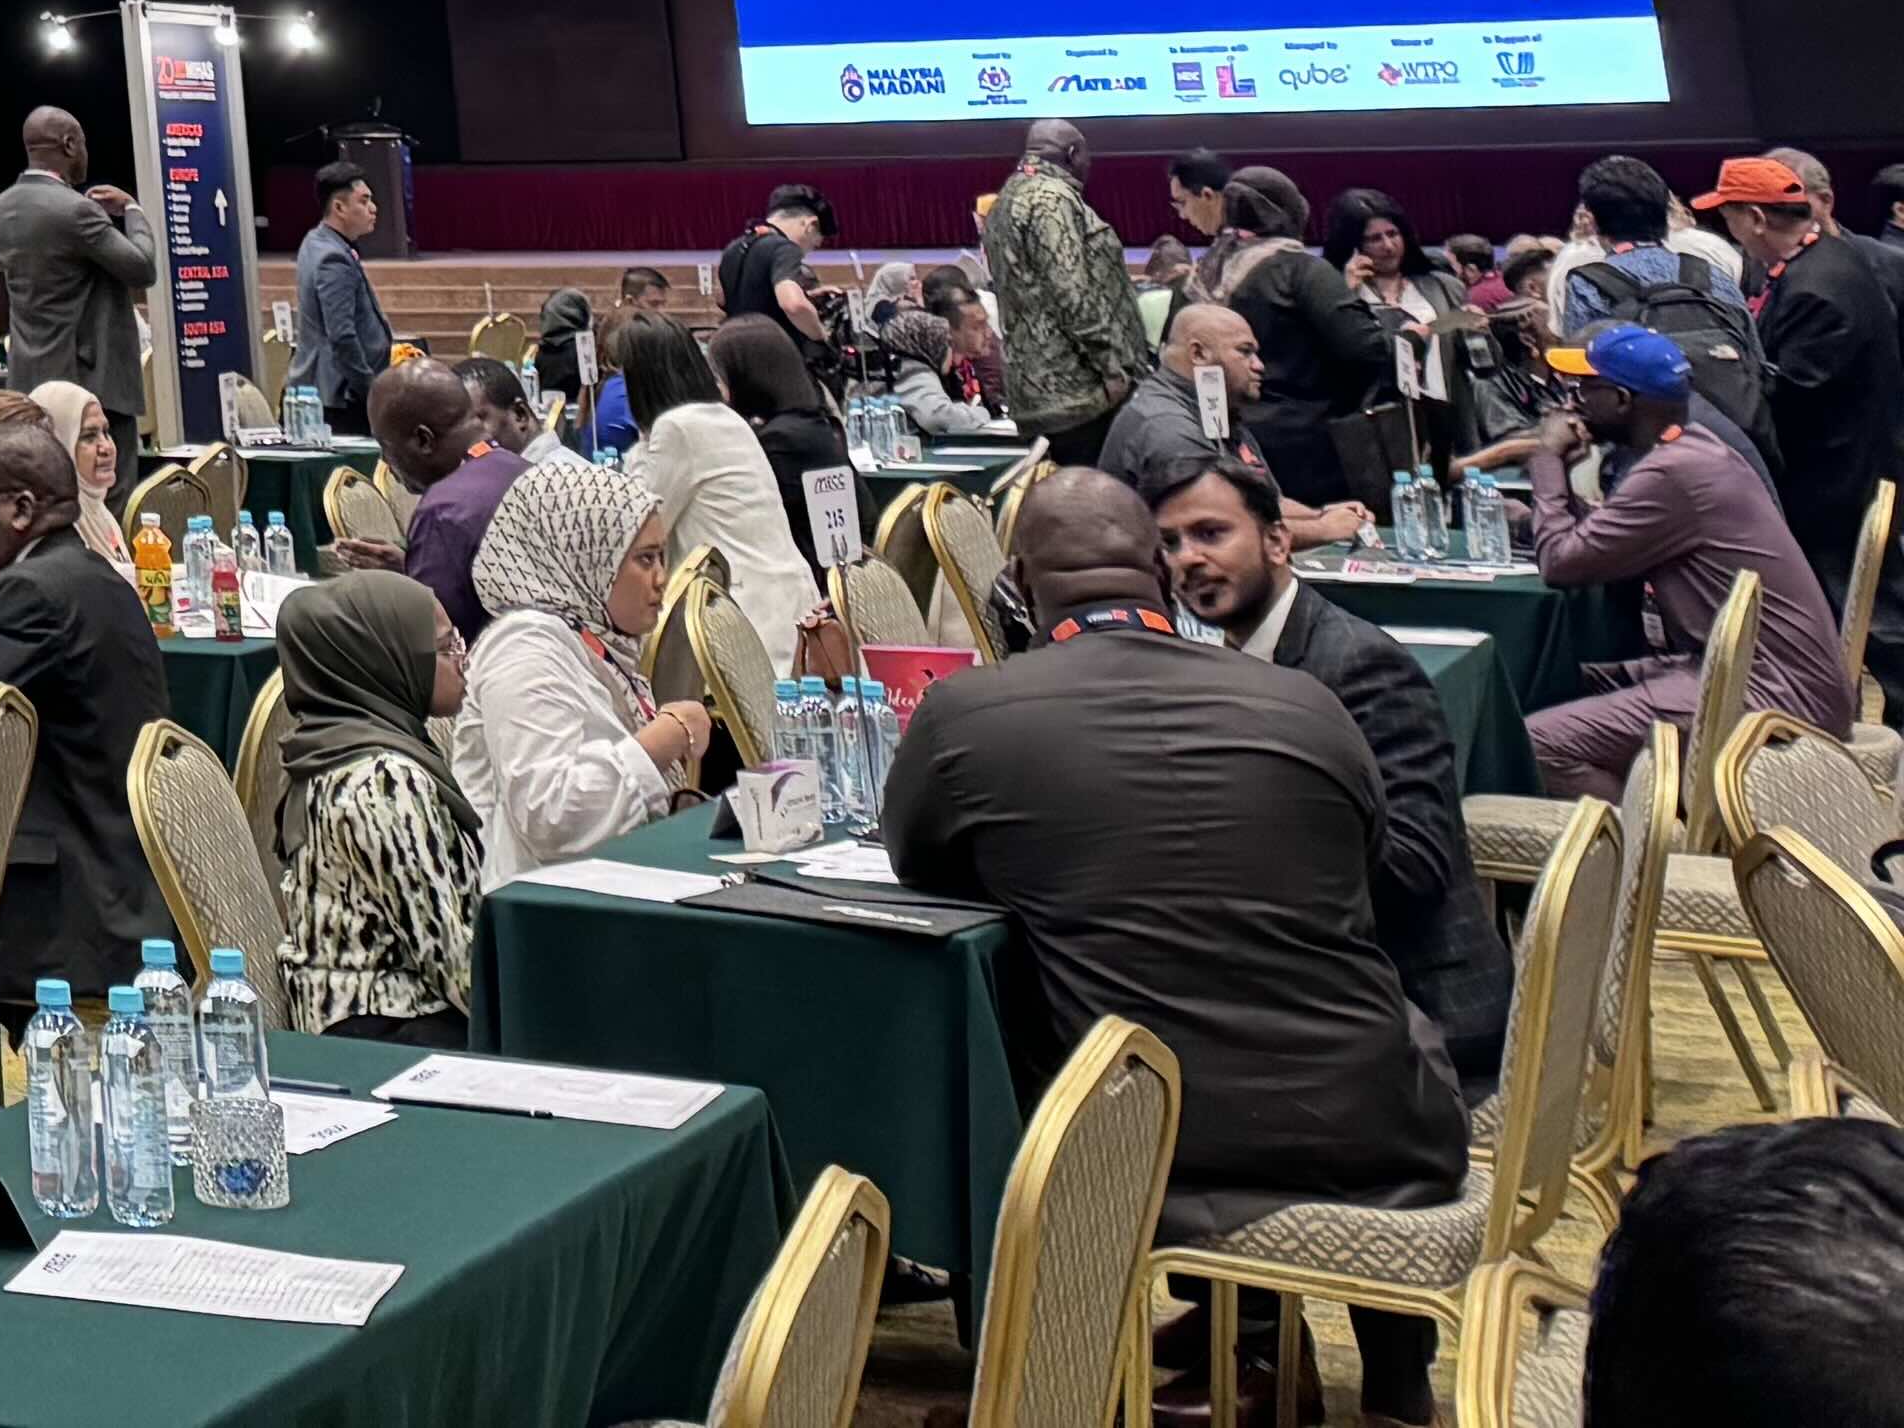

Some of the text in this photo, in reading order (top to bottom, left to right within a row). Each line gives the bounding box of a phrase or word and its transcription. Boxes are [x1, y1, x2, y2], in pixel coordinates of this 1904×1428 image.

[1048, 74, 1147, 92] MATRADE
[1279, 63, 1349, 90] qube
[869, 78, 946, 96] MADANI
